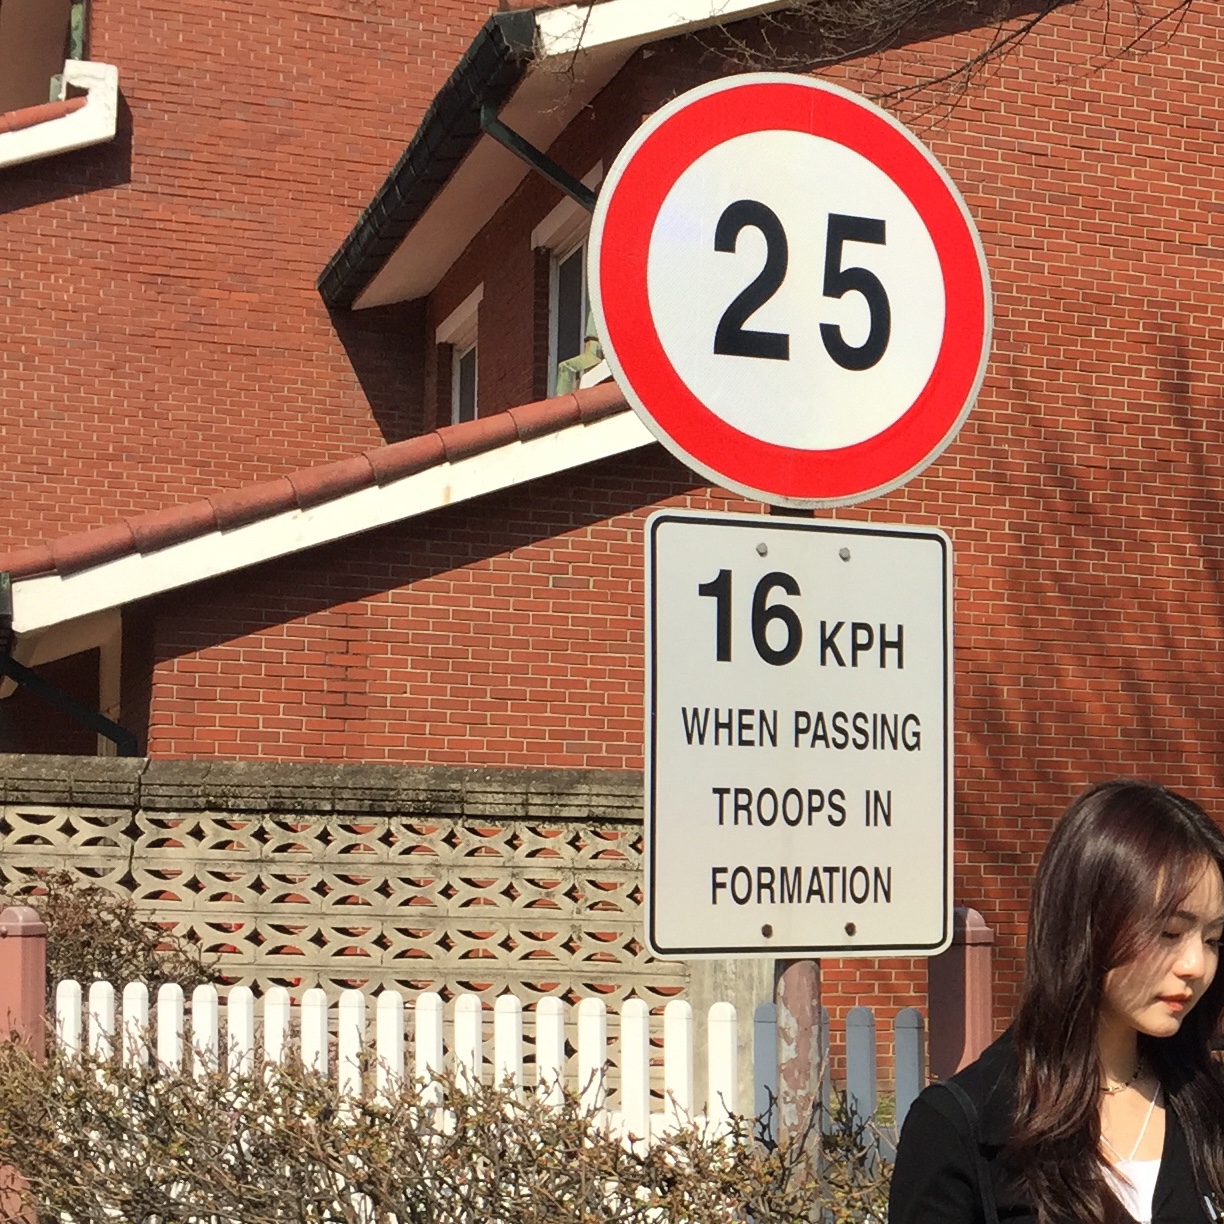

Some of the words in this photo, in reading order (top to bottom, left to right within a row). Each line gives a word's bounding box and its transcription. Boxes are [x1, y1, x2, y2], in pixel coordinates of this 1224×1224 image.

[713, 199, 892, 371] 25
[698, 569, 803, 666] 16
[819, 620, 905, 669] KPH
[682, 707, 778, 748] WHEN
[794, 711, 921, 751] PASSING
[712, 787, 847, 827] TROOPS
[865, 790, 892, 827] IN
[711, 865, 892, 904] FORMATION
